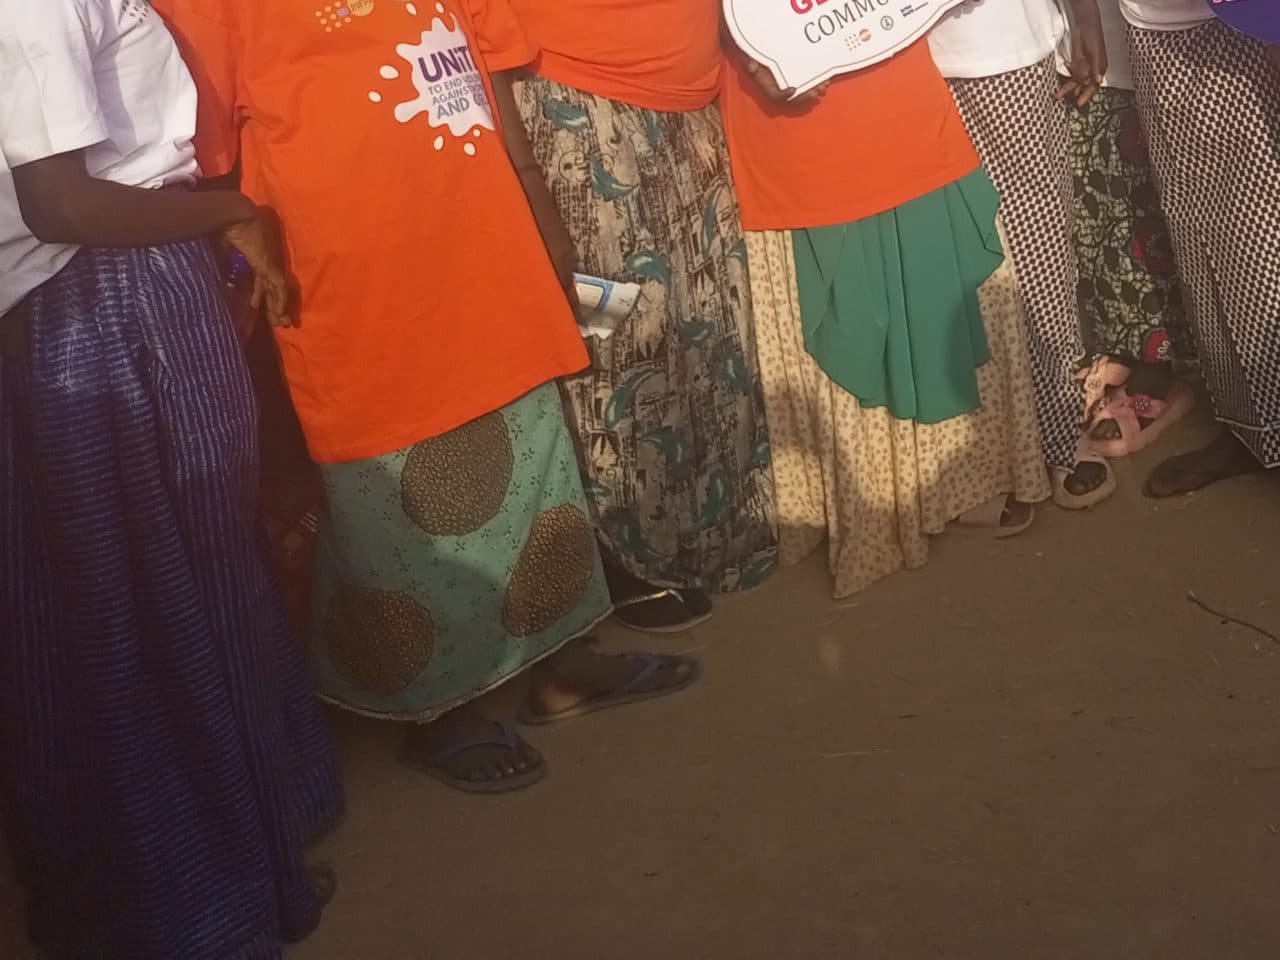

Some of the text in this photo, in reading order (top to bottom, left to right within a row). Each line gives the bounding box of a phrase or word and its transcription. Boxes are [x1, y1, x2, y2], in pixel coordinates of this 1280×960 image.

[418, 46, 473, 82] UNiT
[427, 84, 443, 95] TO
[443, 77, 462, 91] END
[437, 97, 470, 120] AND
